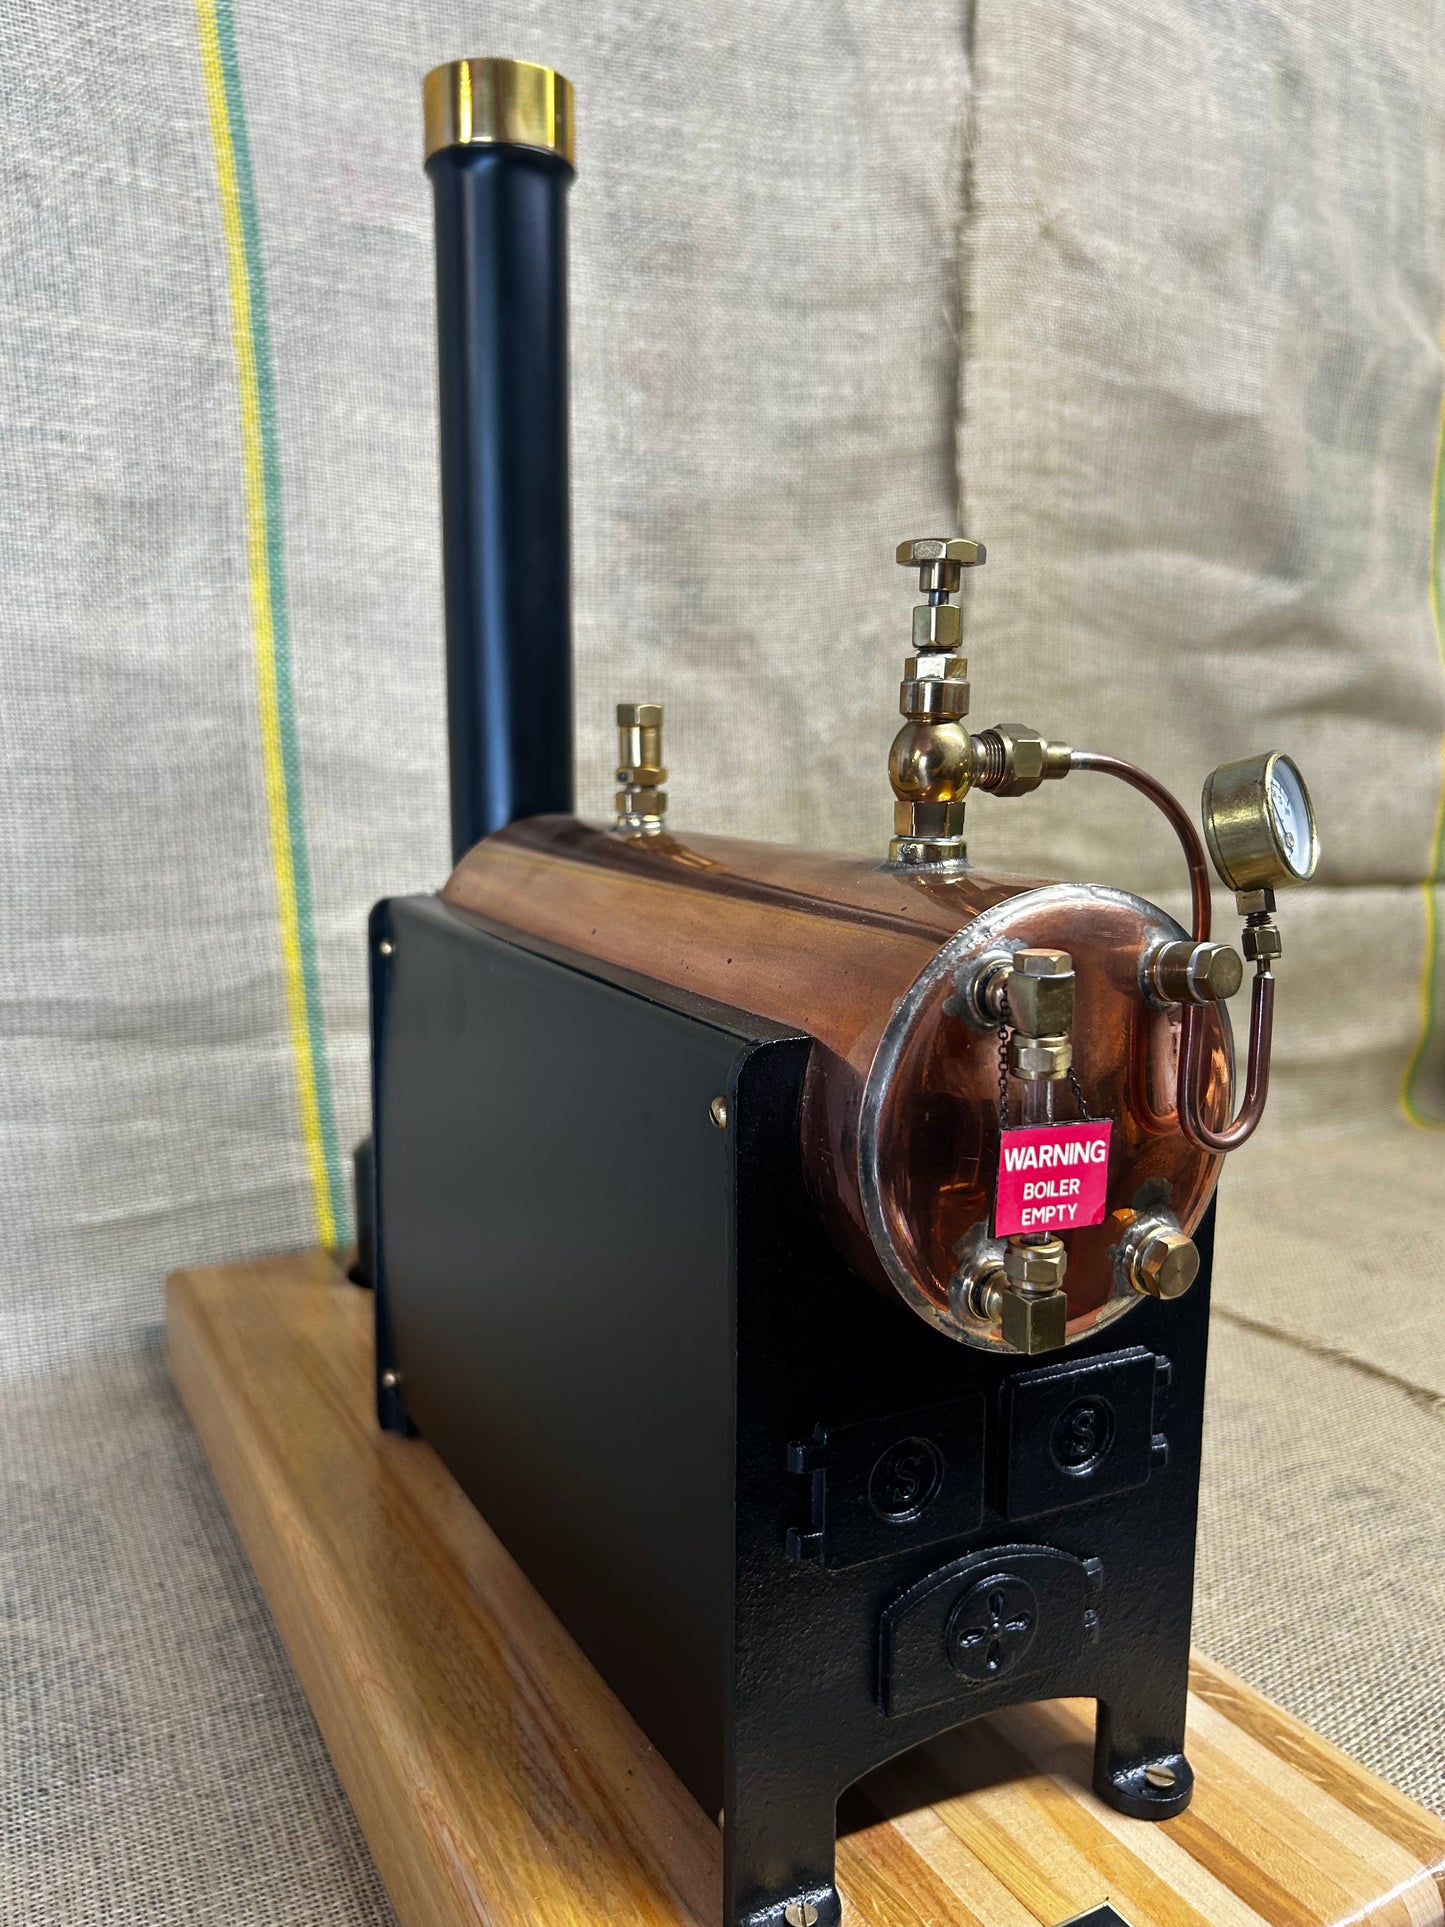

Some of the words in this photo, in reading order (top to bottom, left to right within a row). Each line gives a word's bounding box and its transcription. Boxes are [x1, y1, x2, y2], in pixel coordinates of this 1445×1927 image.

[1004, 1139, 1107, 1172] WARNING
[1023, 1178, 1081, 1201] BOILER
[1021, 1202, 1078, 1227] EMPTY
[1071, 1409, 1095, 1456] S
[893, 1455, 922, 1502] S
